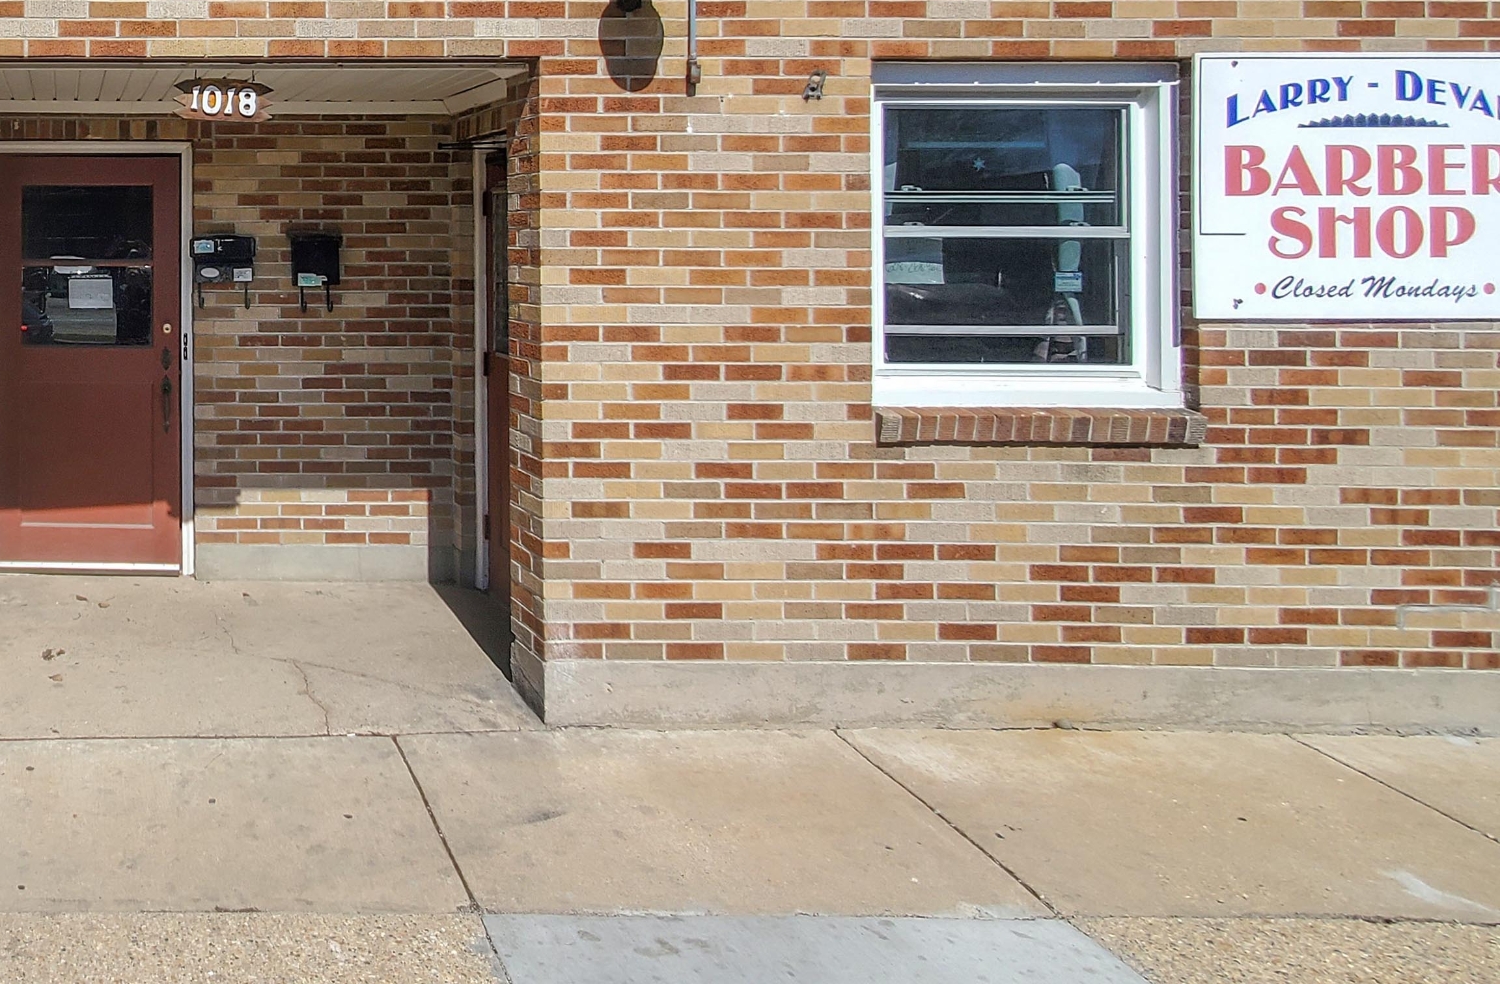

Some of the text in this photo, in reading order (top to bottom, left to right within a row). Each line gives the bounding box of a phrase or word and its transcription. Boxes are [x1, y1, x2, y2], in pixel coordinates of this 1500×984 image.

[190, 84, 257, 118] 1018
[1226, 75, 1354, 128] LARRY
[1395, 69, 1500, 122] DEVA
[1224, 144, 1500, 197] BARBER
[1268, 205, 1476, 259] SHOP
[1271, 275, 1478, 303] Closed Mondays
